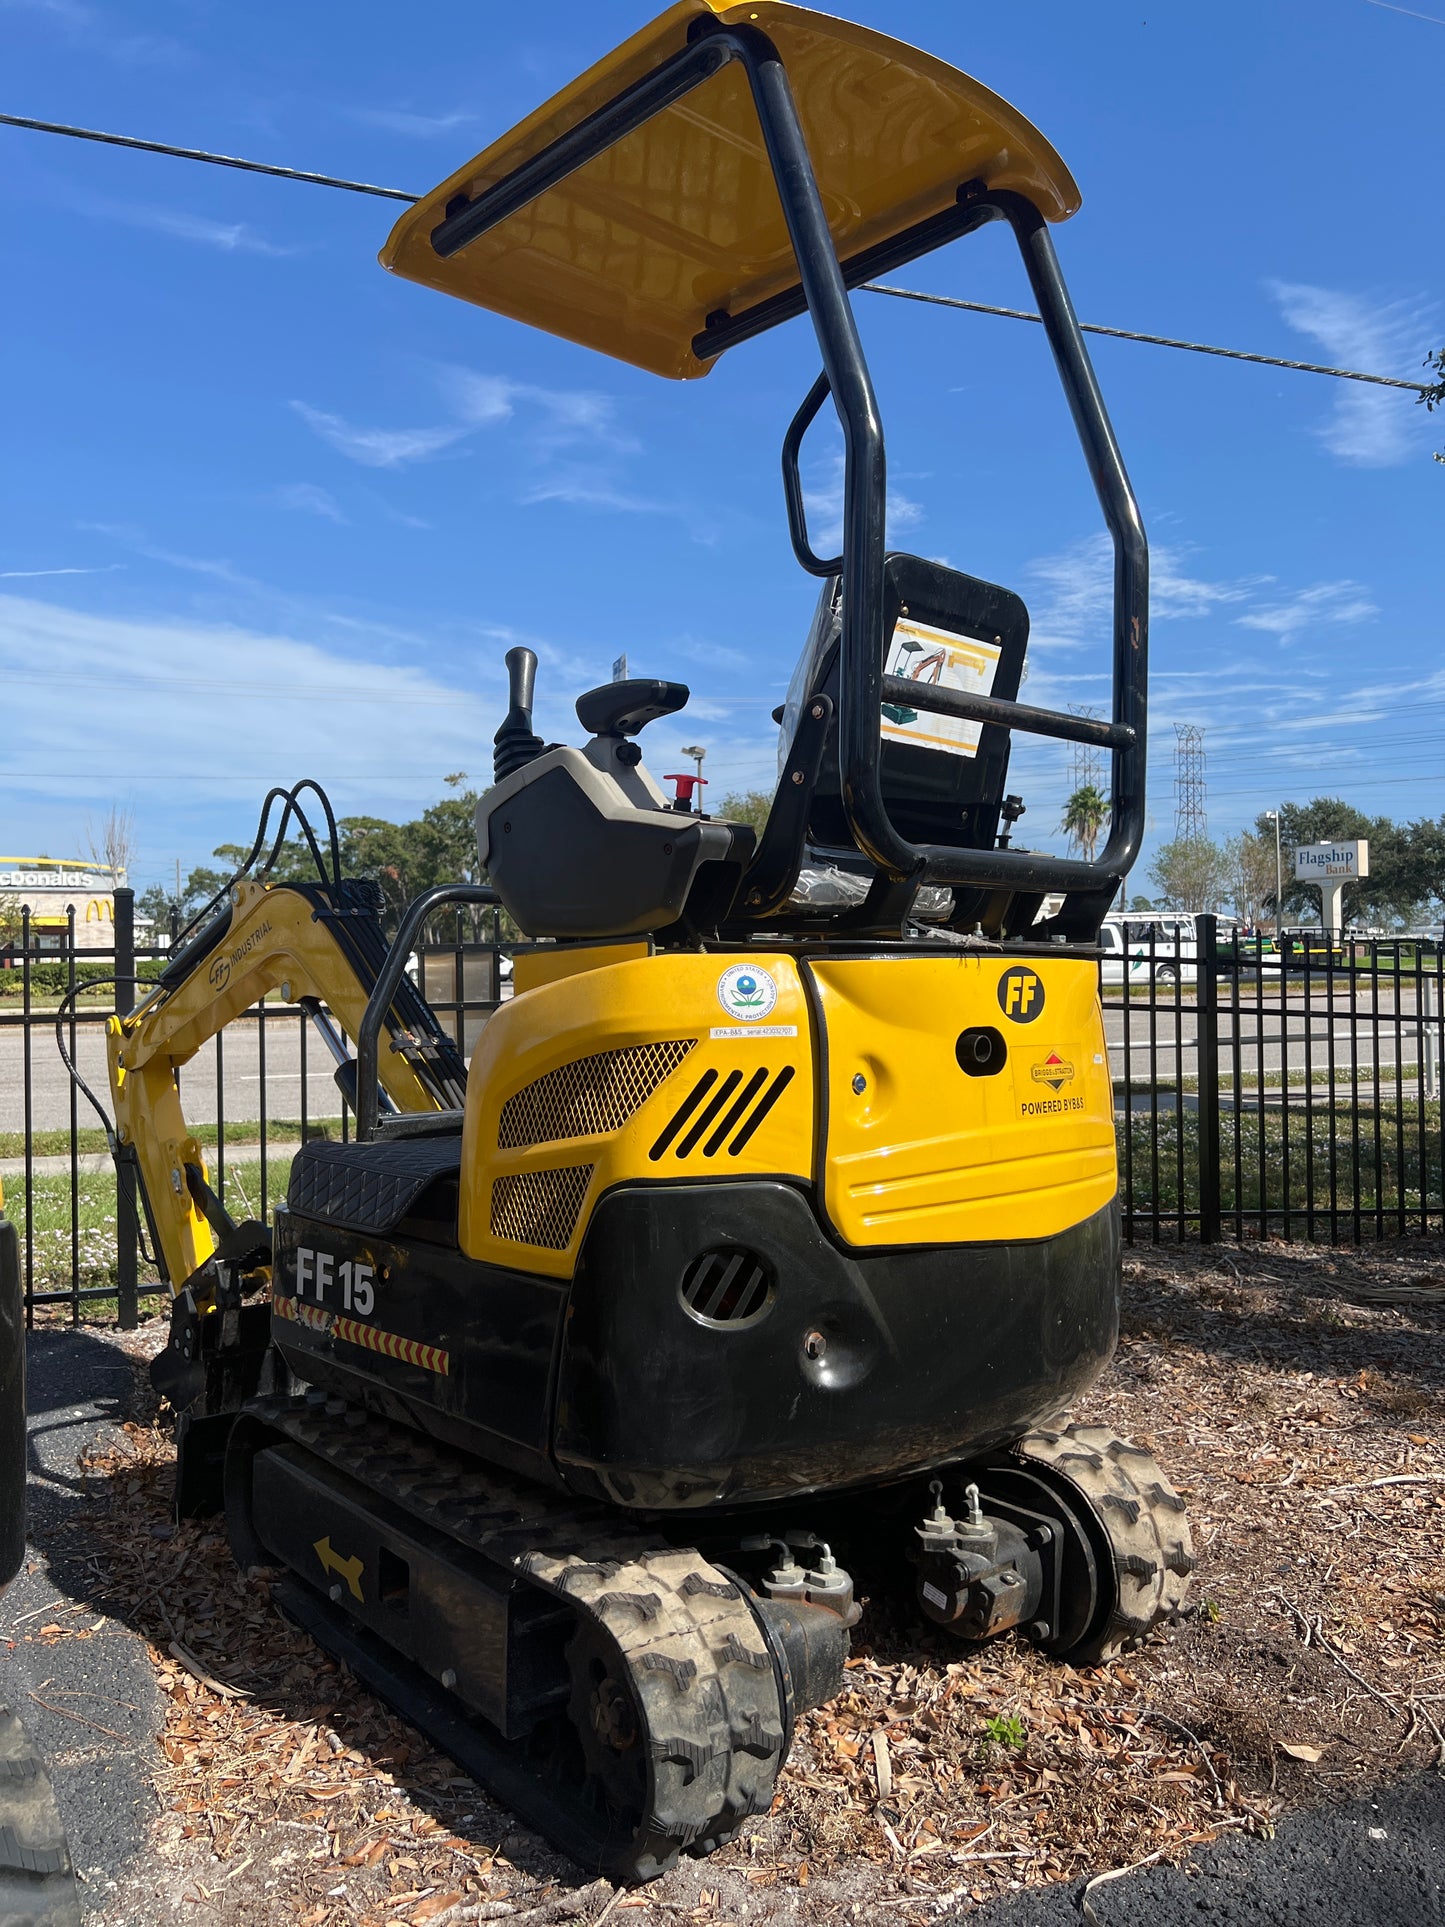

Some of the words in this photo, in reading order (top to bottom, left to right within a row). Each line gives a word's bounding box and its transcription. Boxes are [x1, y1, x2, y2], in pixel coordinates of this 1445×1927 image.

[1299, 848, 1353, 867] Flagship
[1326, 864, 1352, 875] Bank
[229, 919, 273, 967] INDUSTRIAL
[727, 967, 744, 977] UNITED
[745, 966, 764, 976] STATES
[1006, 975, 1037, 1015] FF
[745, 1001, 774, 1019] PROTECTION
[1021, 1100, 1062, 1116] POWERED
